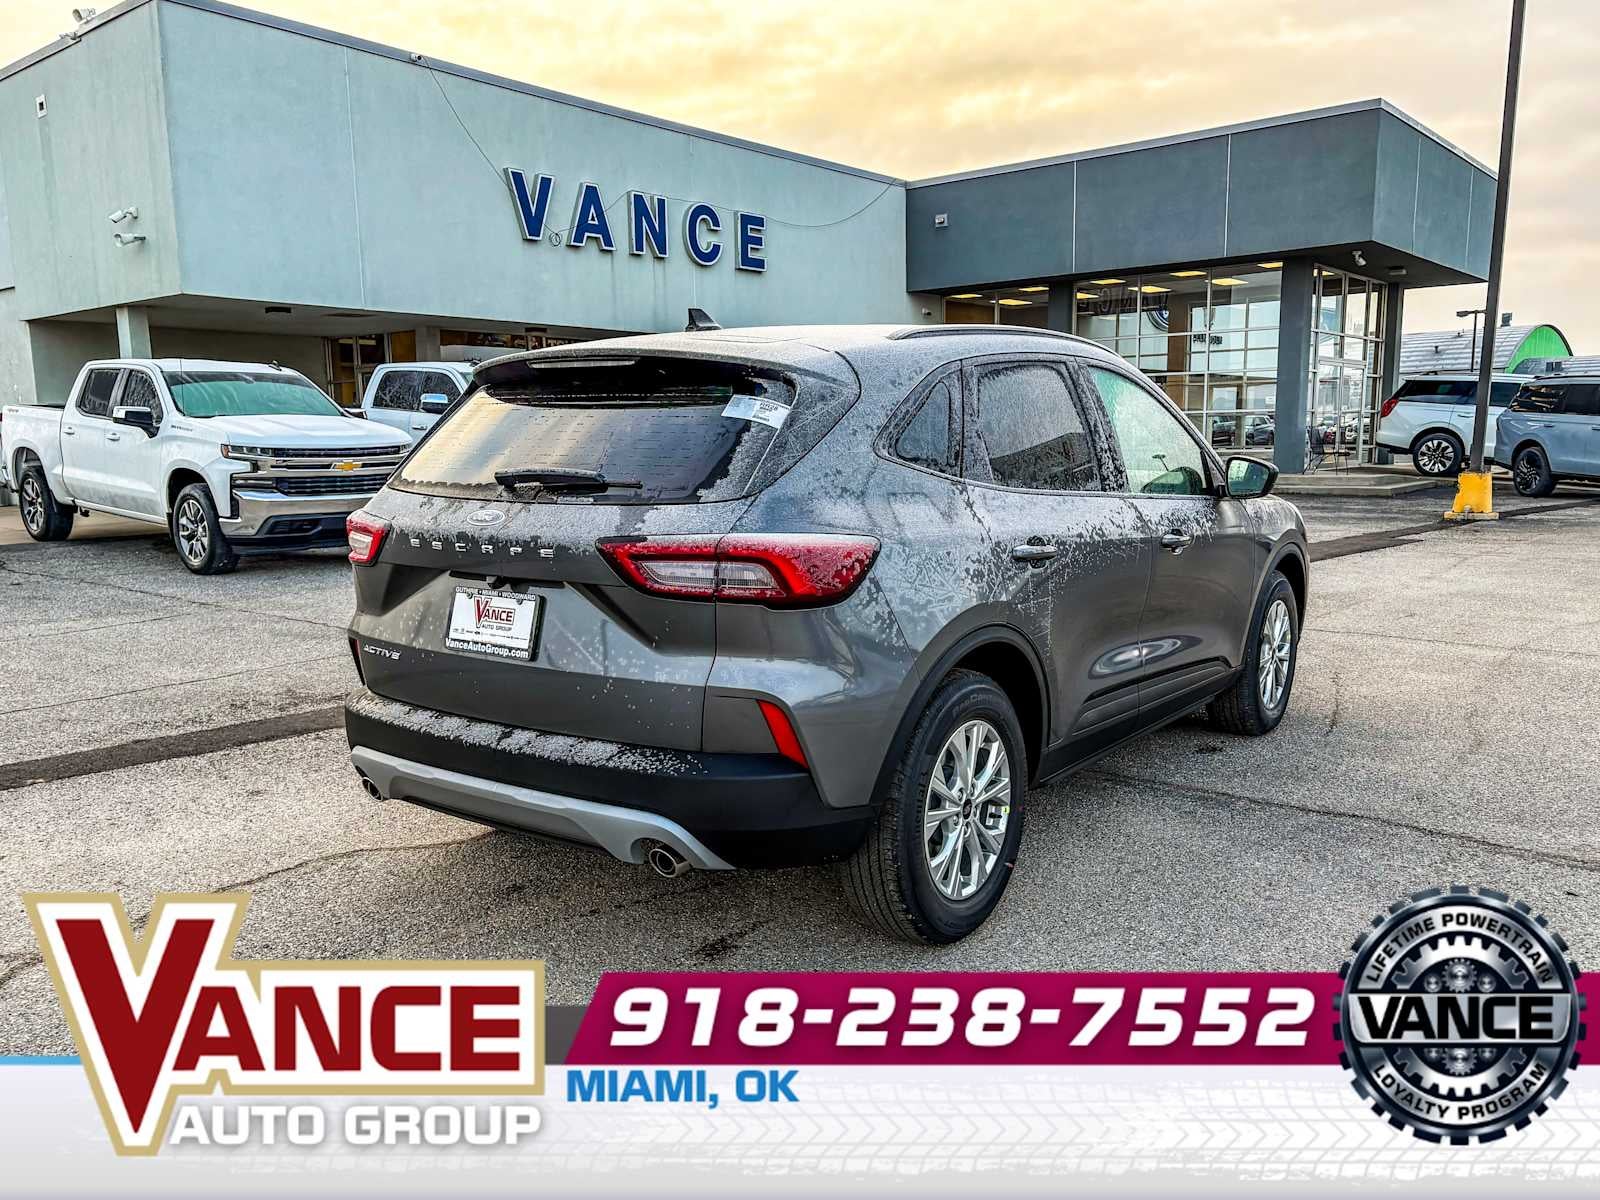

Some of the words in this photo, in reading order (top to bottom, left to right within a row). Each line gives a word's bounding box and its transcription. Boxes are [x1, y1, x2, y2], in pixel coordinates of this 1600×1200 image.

[503, 167, 768, 272] VANCE
[475, 597, 514, 626] VANCE
[363, 644, 402, 660] ACTIVE
[445, 637, 529, 660] VanceAutoGroup.com
